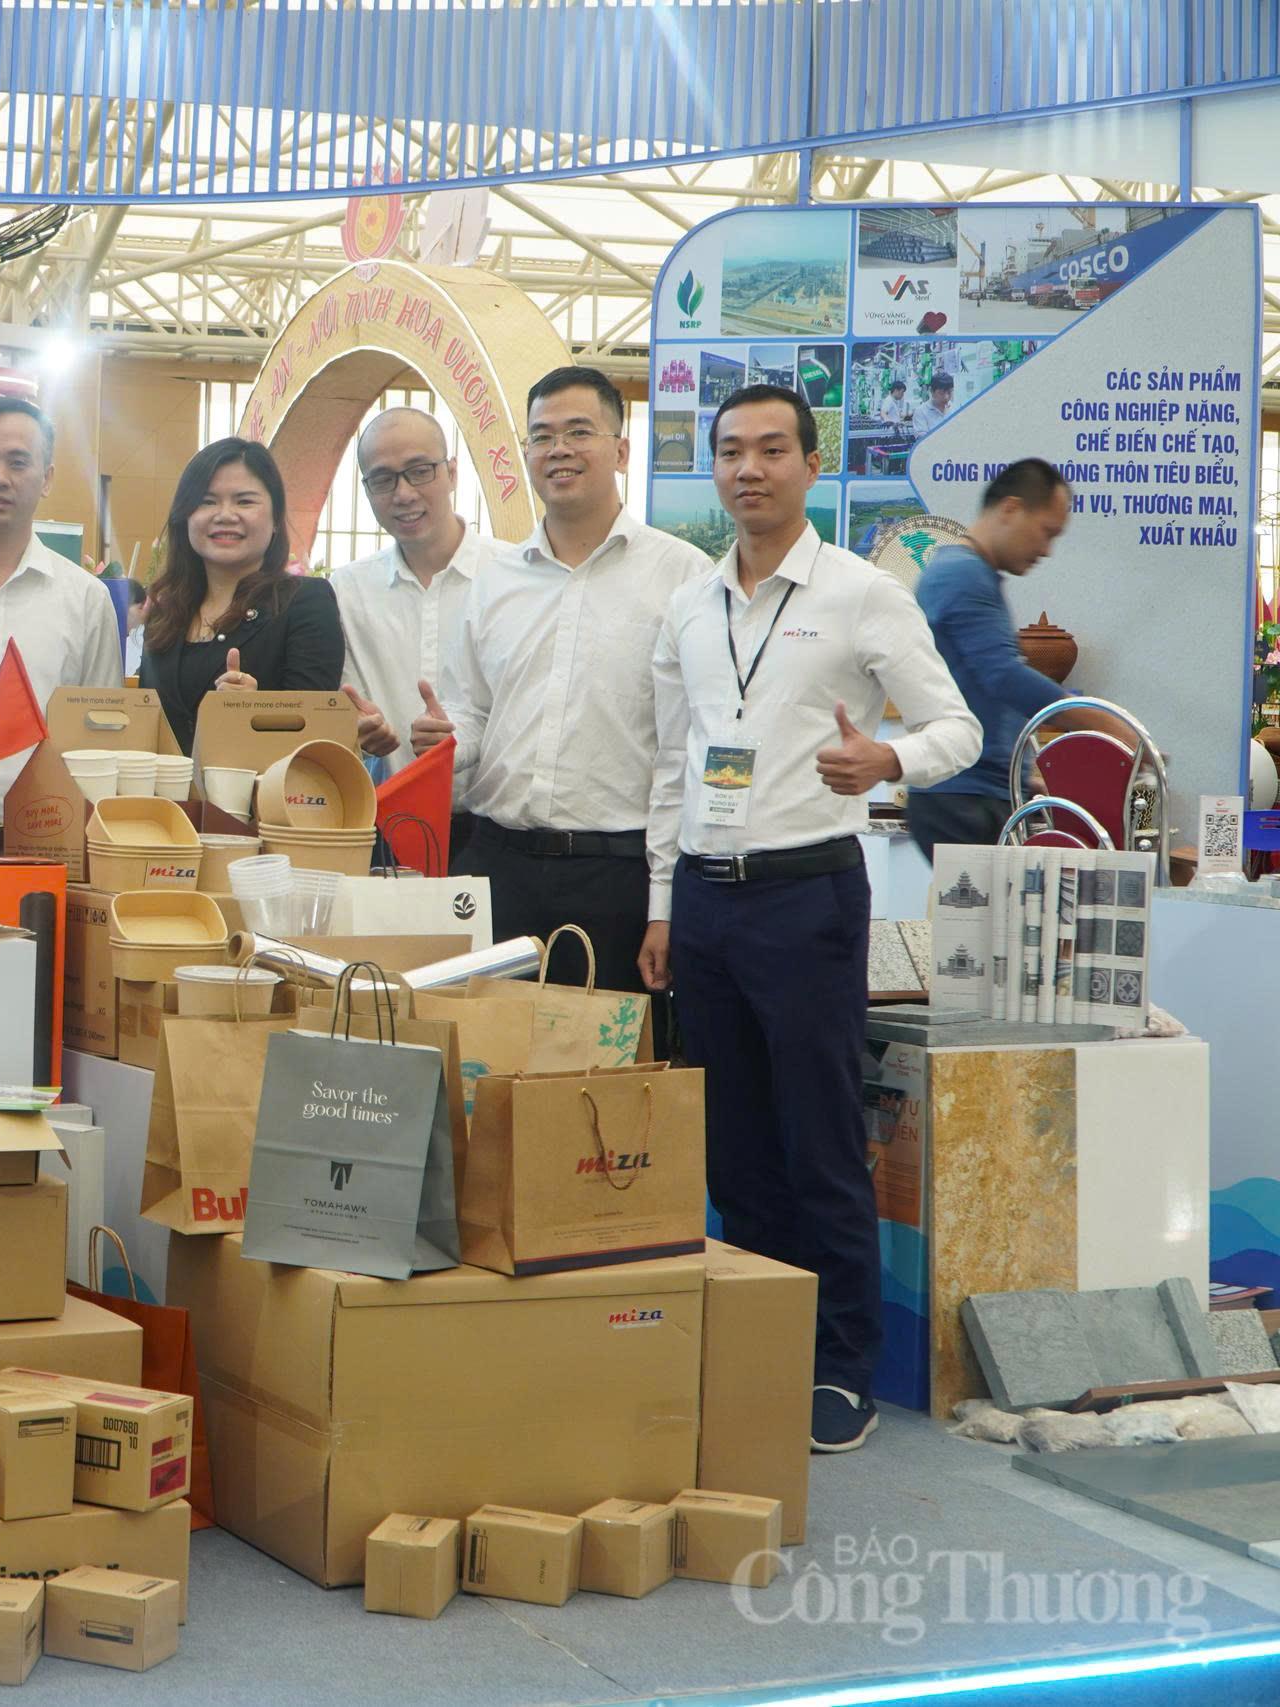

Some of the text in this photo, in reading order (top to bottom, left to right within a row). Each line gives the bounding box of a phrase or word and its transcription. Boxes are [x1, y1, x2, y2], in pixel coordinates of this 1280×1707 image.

[1059, 245, 1129, 282] COSCO
[680, 321, 702, 329] NSRP
[1106, 364, 1241, 392] CÁC SẢN PHẨM
[395, 293, 445, 350] HOA
[488, 445, 519, 502] XA
[1061, 399, 1240, 426] CÔNG NGHIỆP NẶNG,
[1076, 428, 1239, 457] CHẾ BIẾN CHẾ TẠO,
[932, 460, 979, 482] CÔNG
[1105, 460, 1149, 483] THÔN
[1153, 460, 1190, 484] TIÊU
[1195, 457, 1239, 486] BIỂU,
[1090, 495, 1117, 518] VỤ,
[1123, 494, 1193, 515] THƯƠNG
[1198, 496, 1238, 519] MẠI,
[1139, 519, 1237, 546] XUẤT KHẨU
[223, 701, 240, 709] Here
[242, 701, 251, 709] for
[150, 864, 196, 878] miza
[312, 1081, 388, 1106] Savor the
[302, 1102, 348, 1121] good
[303, 1198, 368, 1214] TOMAHAWK
[609, 1307, 664, 1323] miza
[103, 1416, 139, 1435] 0007680
[129, 1437, 138, 1450] 10
